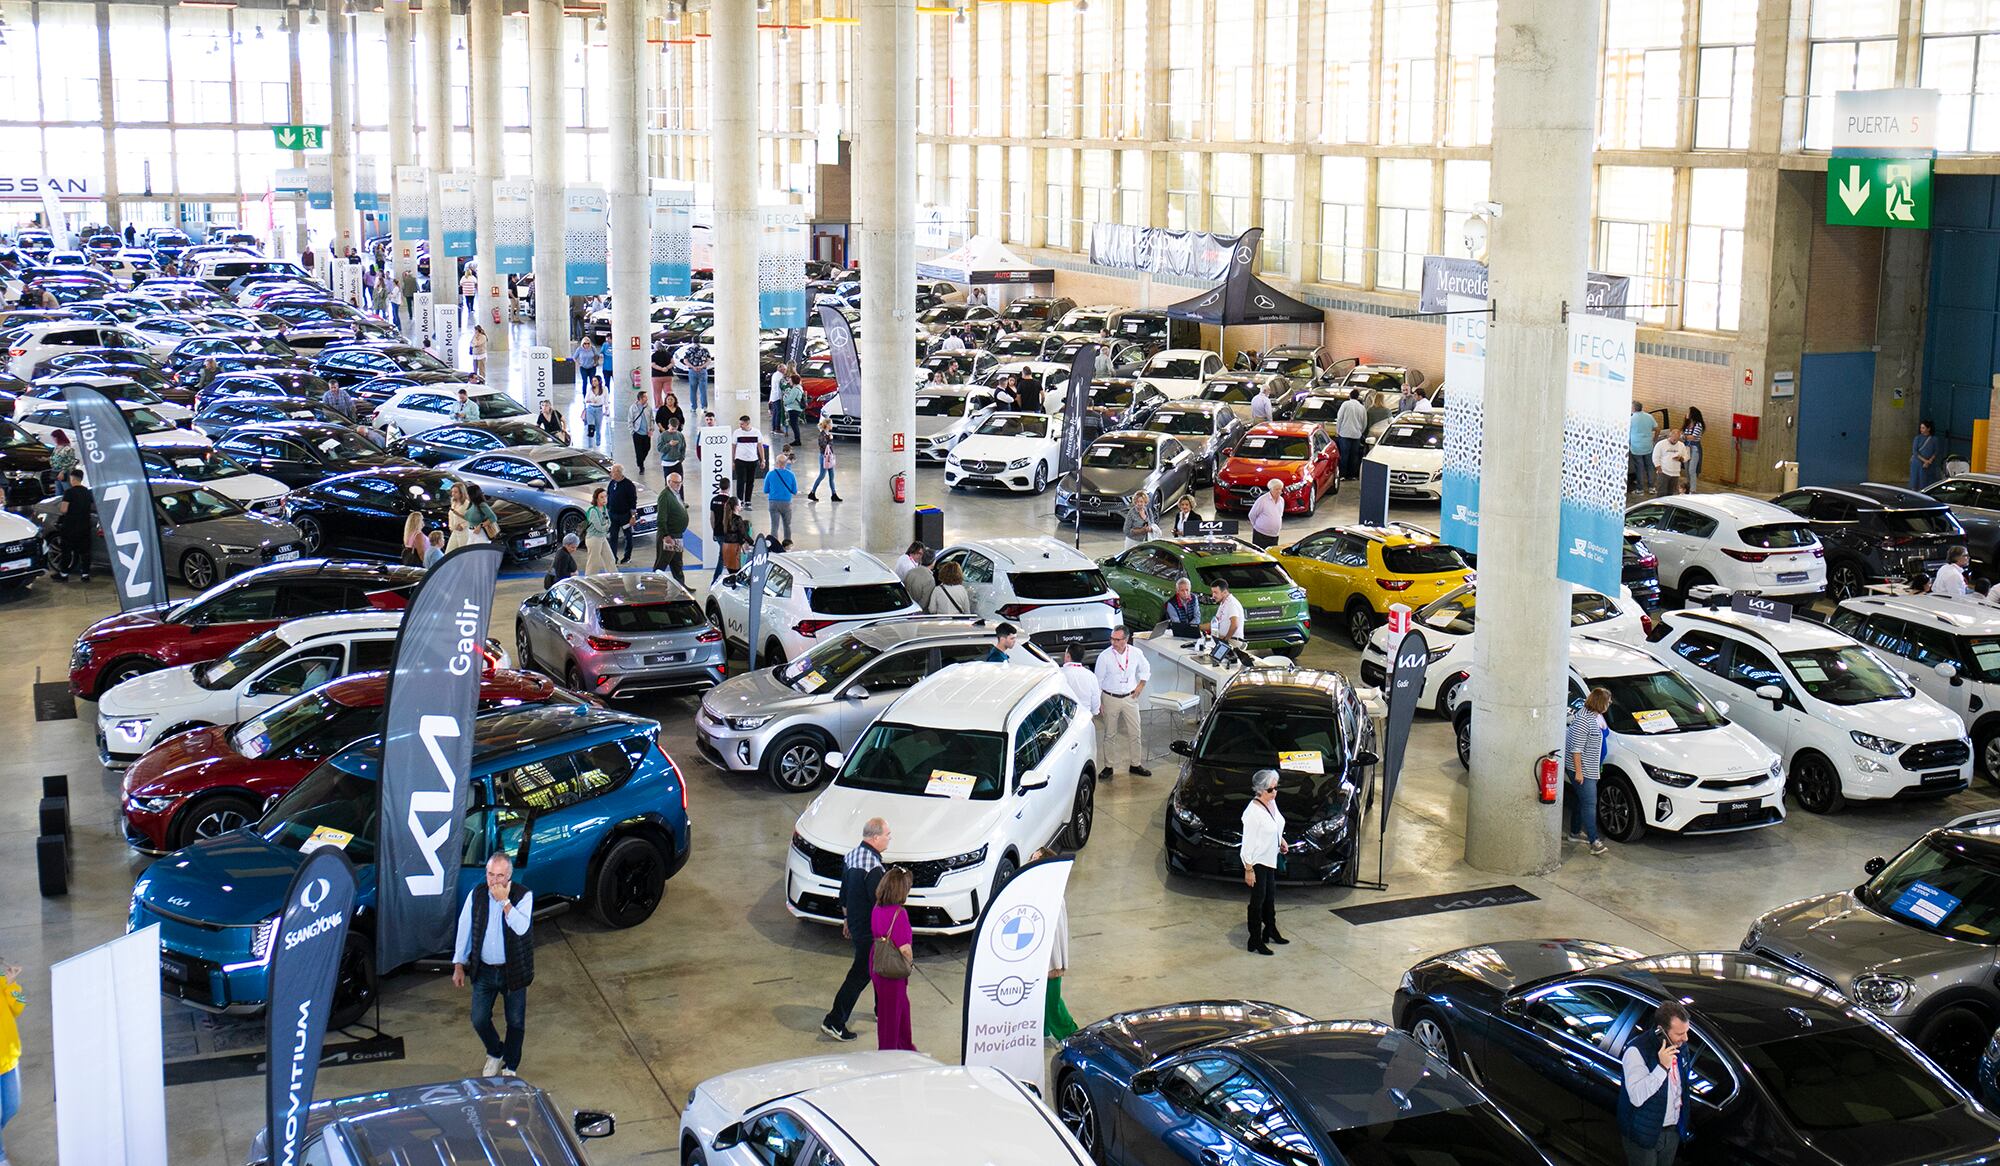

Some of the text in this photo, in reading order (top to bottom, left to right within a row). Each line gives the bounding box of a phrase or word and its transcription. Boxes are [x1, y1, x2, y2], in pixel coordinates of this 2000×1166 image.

[1847, 116, 1920, 133] PUERTA 5
[0, 178, 87, 193] SSAN
[442, 179, 468, 187] IFECA
[496, 186, 528, 196] IFECA
[568, 196, 603, 206] IFECA
[655, 197, 689, 206] IFECA
[762, 214, 801, 225] IFECA
[1437, 270, 1488, 297] Mercede
[421, 308, 429, 332] Motor
[1452, 316, 1487, 340] IFEC
[1573, 333, 1628, 364] IFECA
[445, 349, 453, 369] lera
[537, 366, 546, 397] Motor
[712, 453, 723, 495] Motor
[1199, 521, 1223, 529] KIA
[753, 552, 768, 567] KIA
[1748, 598, 1775, 611] KIA
[728, 617, 744, 634] KIA
[449, 598, 481, 676] Gadir
[1398, 653, 1427, 669] KIA
[1396, 679, 1410, 688] Gadir
[406, 714, 462, 897] KIA
[1731, 802, 1749, 811] Stonic
[167, 896, 191, 908] KIA
[1433, 896, 1497, 910] KIA
[1001, 908, 1042, 926] BMW
[1000, 986, 1023, 996] MINI
[975, 1018, 1038, 1037] Movijerez
[974, 1035, 1038, 1054] Movicádiz
[352, 1049, 395, 1061] Gadir
[282, 1000, 311, 1166] MOVITIUM
